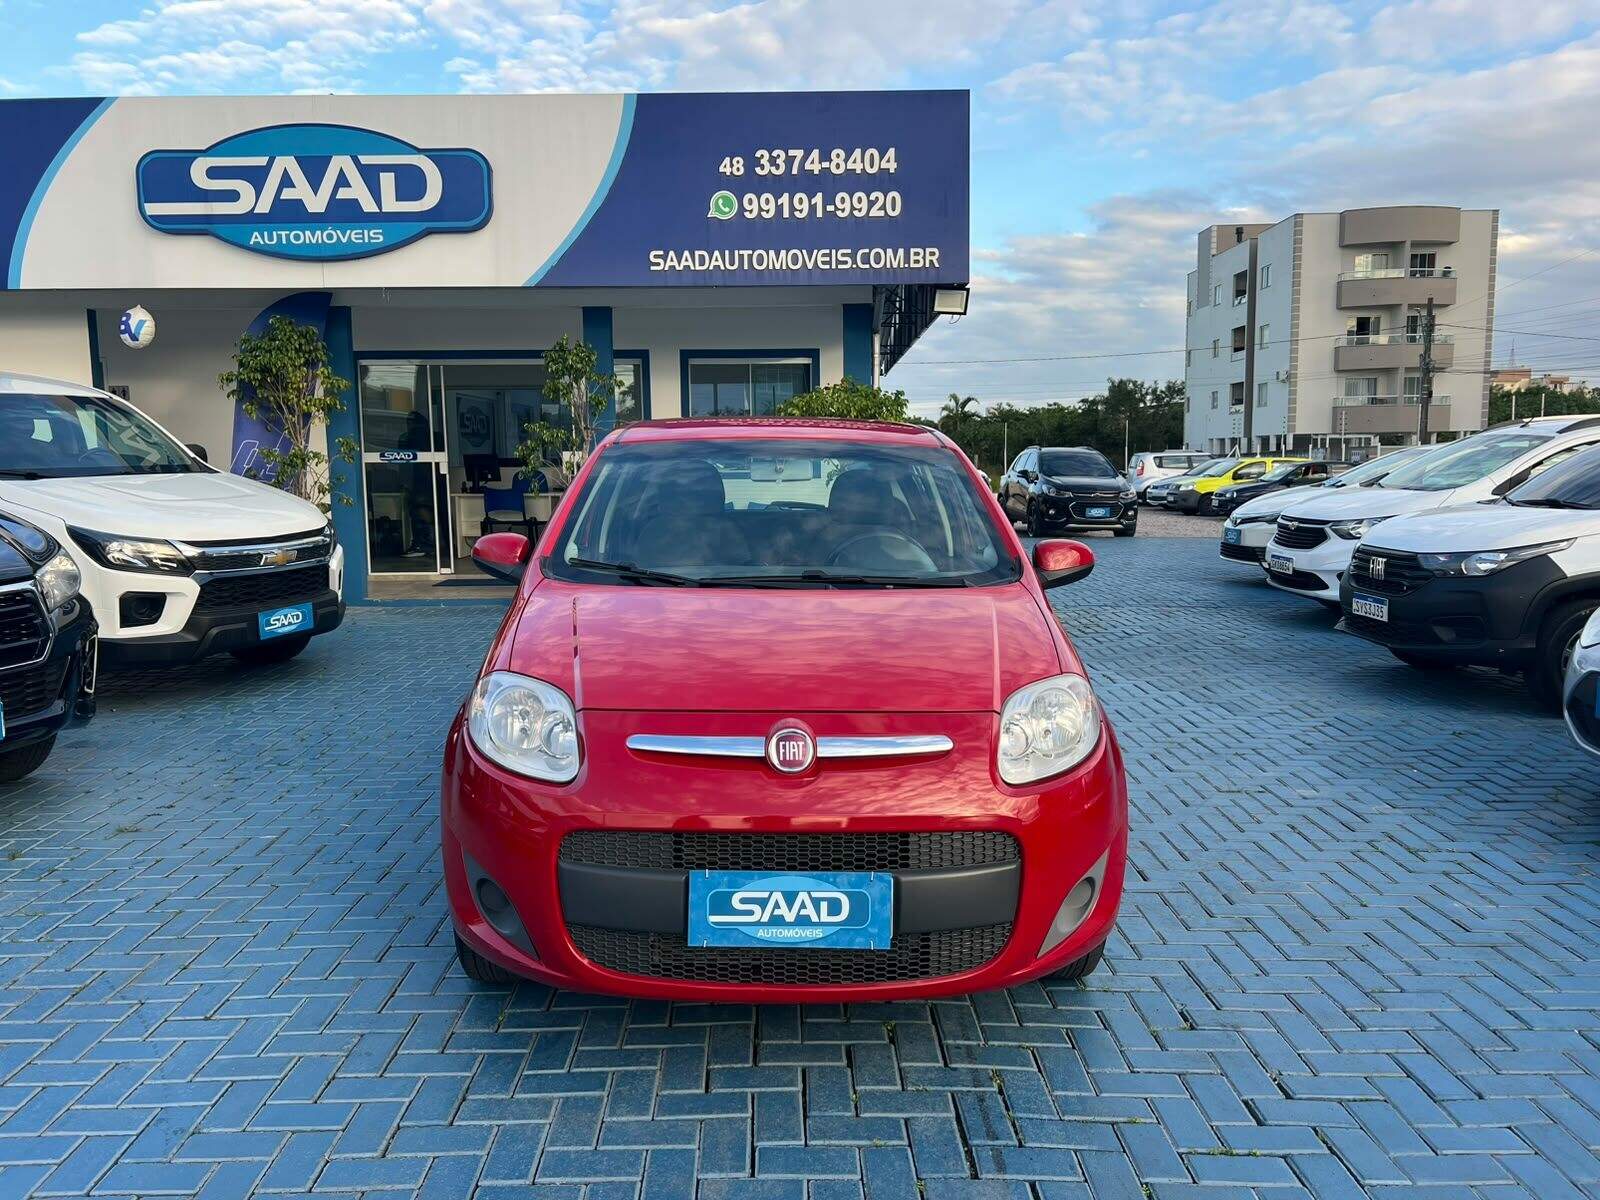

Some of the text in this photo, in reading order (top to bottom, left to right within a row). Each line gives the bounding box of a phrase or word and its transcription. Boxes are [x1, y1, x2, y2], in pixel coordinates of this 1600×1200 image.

[718, 147, 897, 176] 48 3374-8404
[144, 154, 443, 215] SAAD
[742, 190, 902, 219] 99191-9920
[249, 226, 385, 246] AUTOMÓVEIS
[649, 247, 940, 271] SAADAUTOMOVEIS.COM.BR
[380, 451, 413, 460] SAAD
[1369, 556, 1388, 580] FIAT
[264, 611, 303, 631] SAAD
[778, 740, 806, 761] FIAT
[708, 892, 849, 922] SAAD
[756, 927, 823, 938] AUTOMÓVEIS
